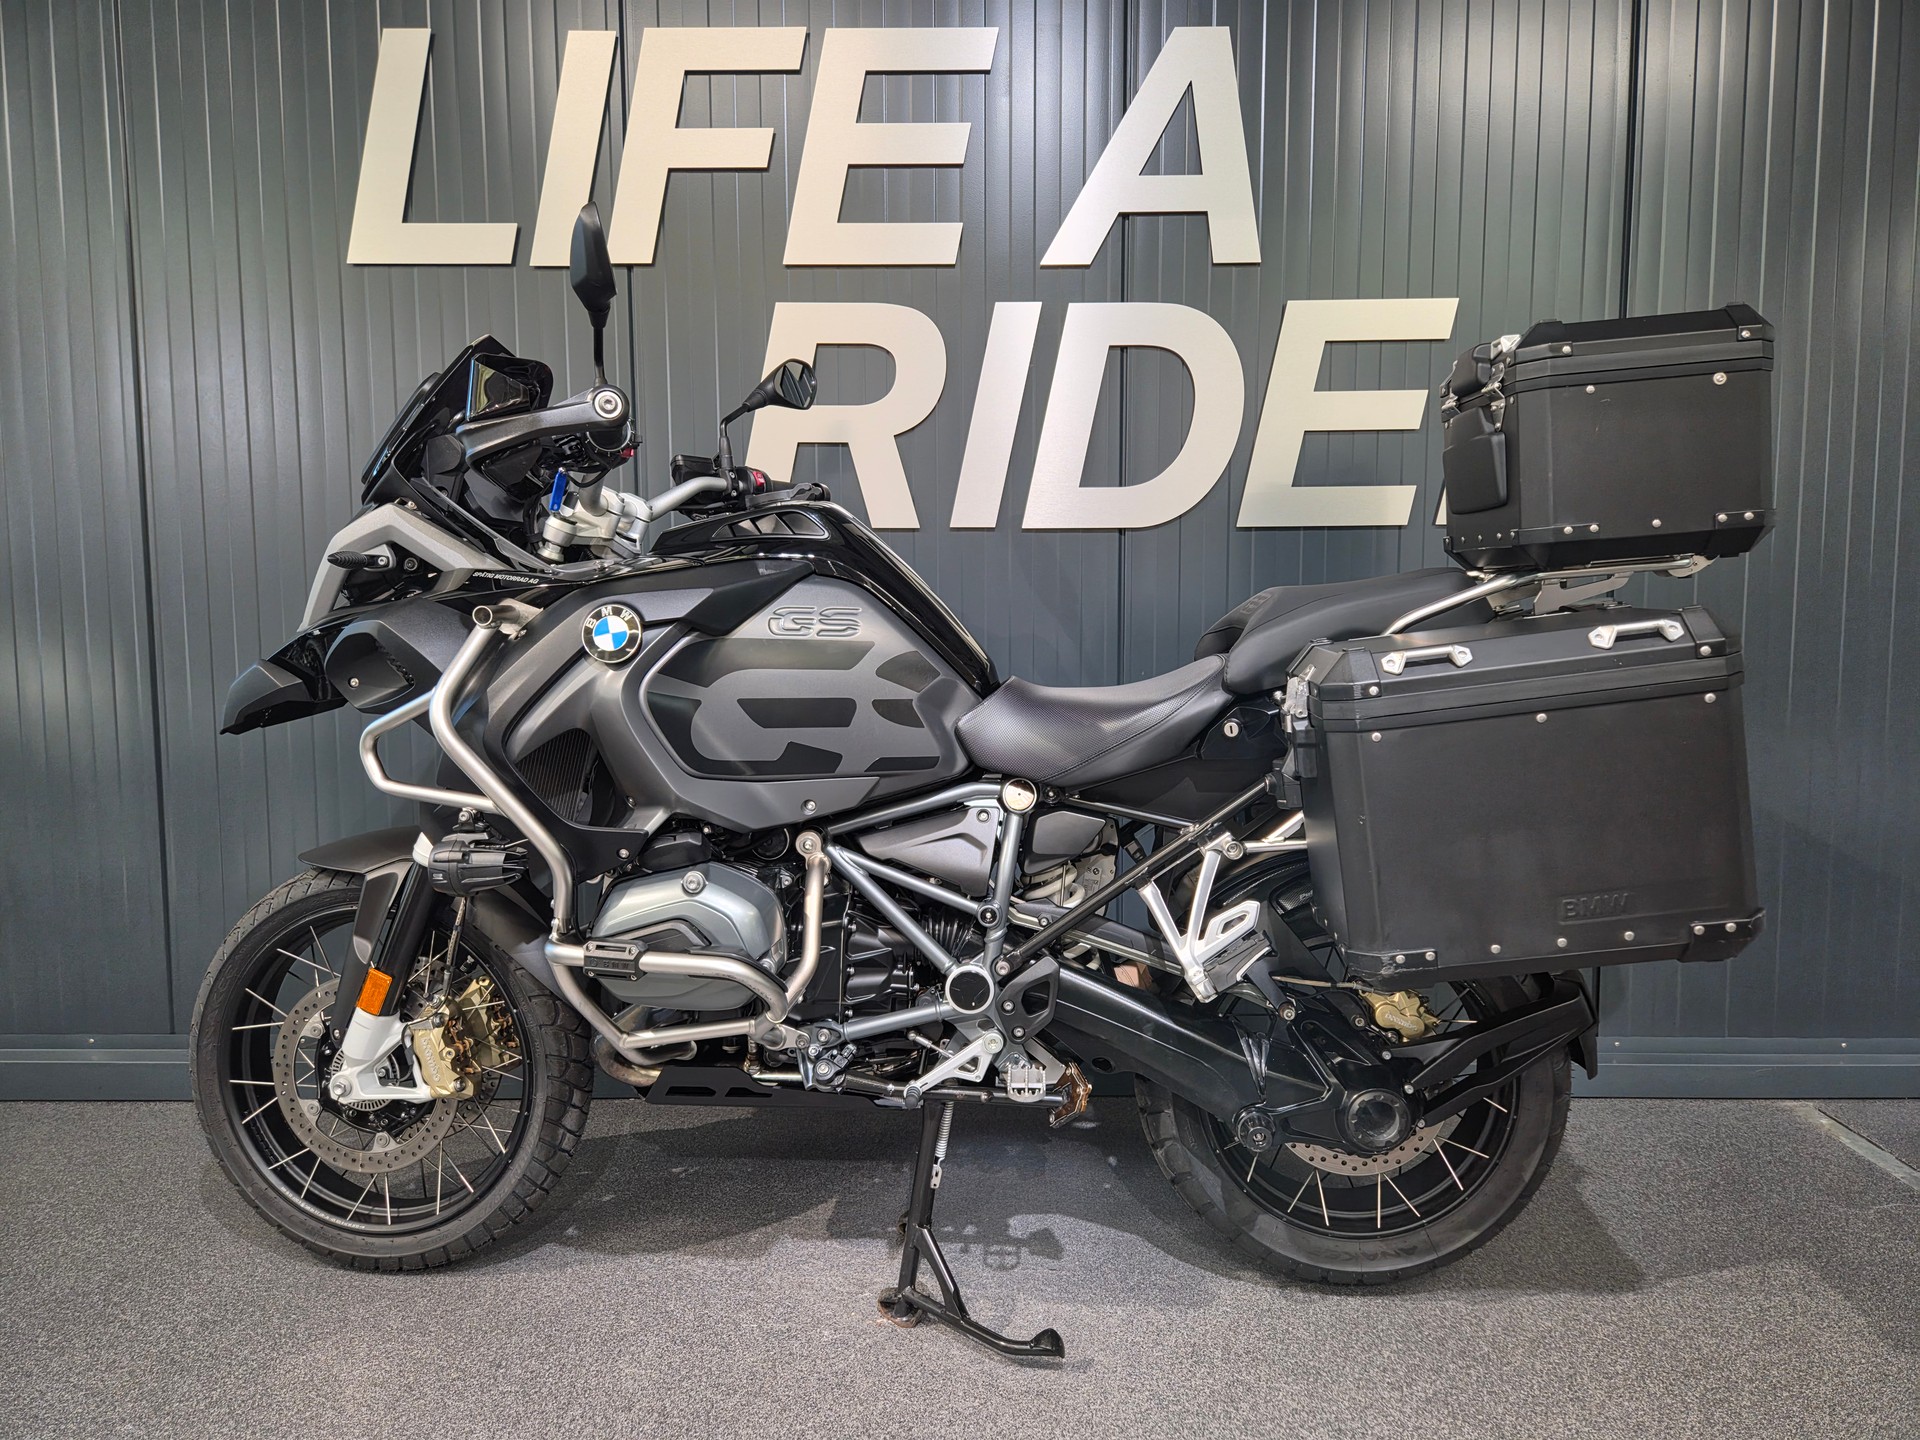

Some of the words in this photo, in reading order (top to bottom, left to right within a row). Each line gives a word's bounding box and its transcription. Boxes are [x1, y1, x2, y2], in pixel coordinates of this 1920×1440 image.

[347, 26, 999, 266] LIFE
[1040, 26, 1262, 266] A
[743, 297, 1459, 529] RIDE
[494, 573, 528, 583] MOTORRAD
[585, 606, 632, 629] BMW
[768, 605, 862, 637] GS
[1561, 892, 1632, 918] BMW
[602, 960, 630, 971] BMW
